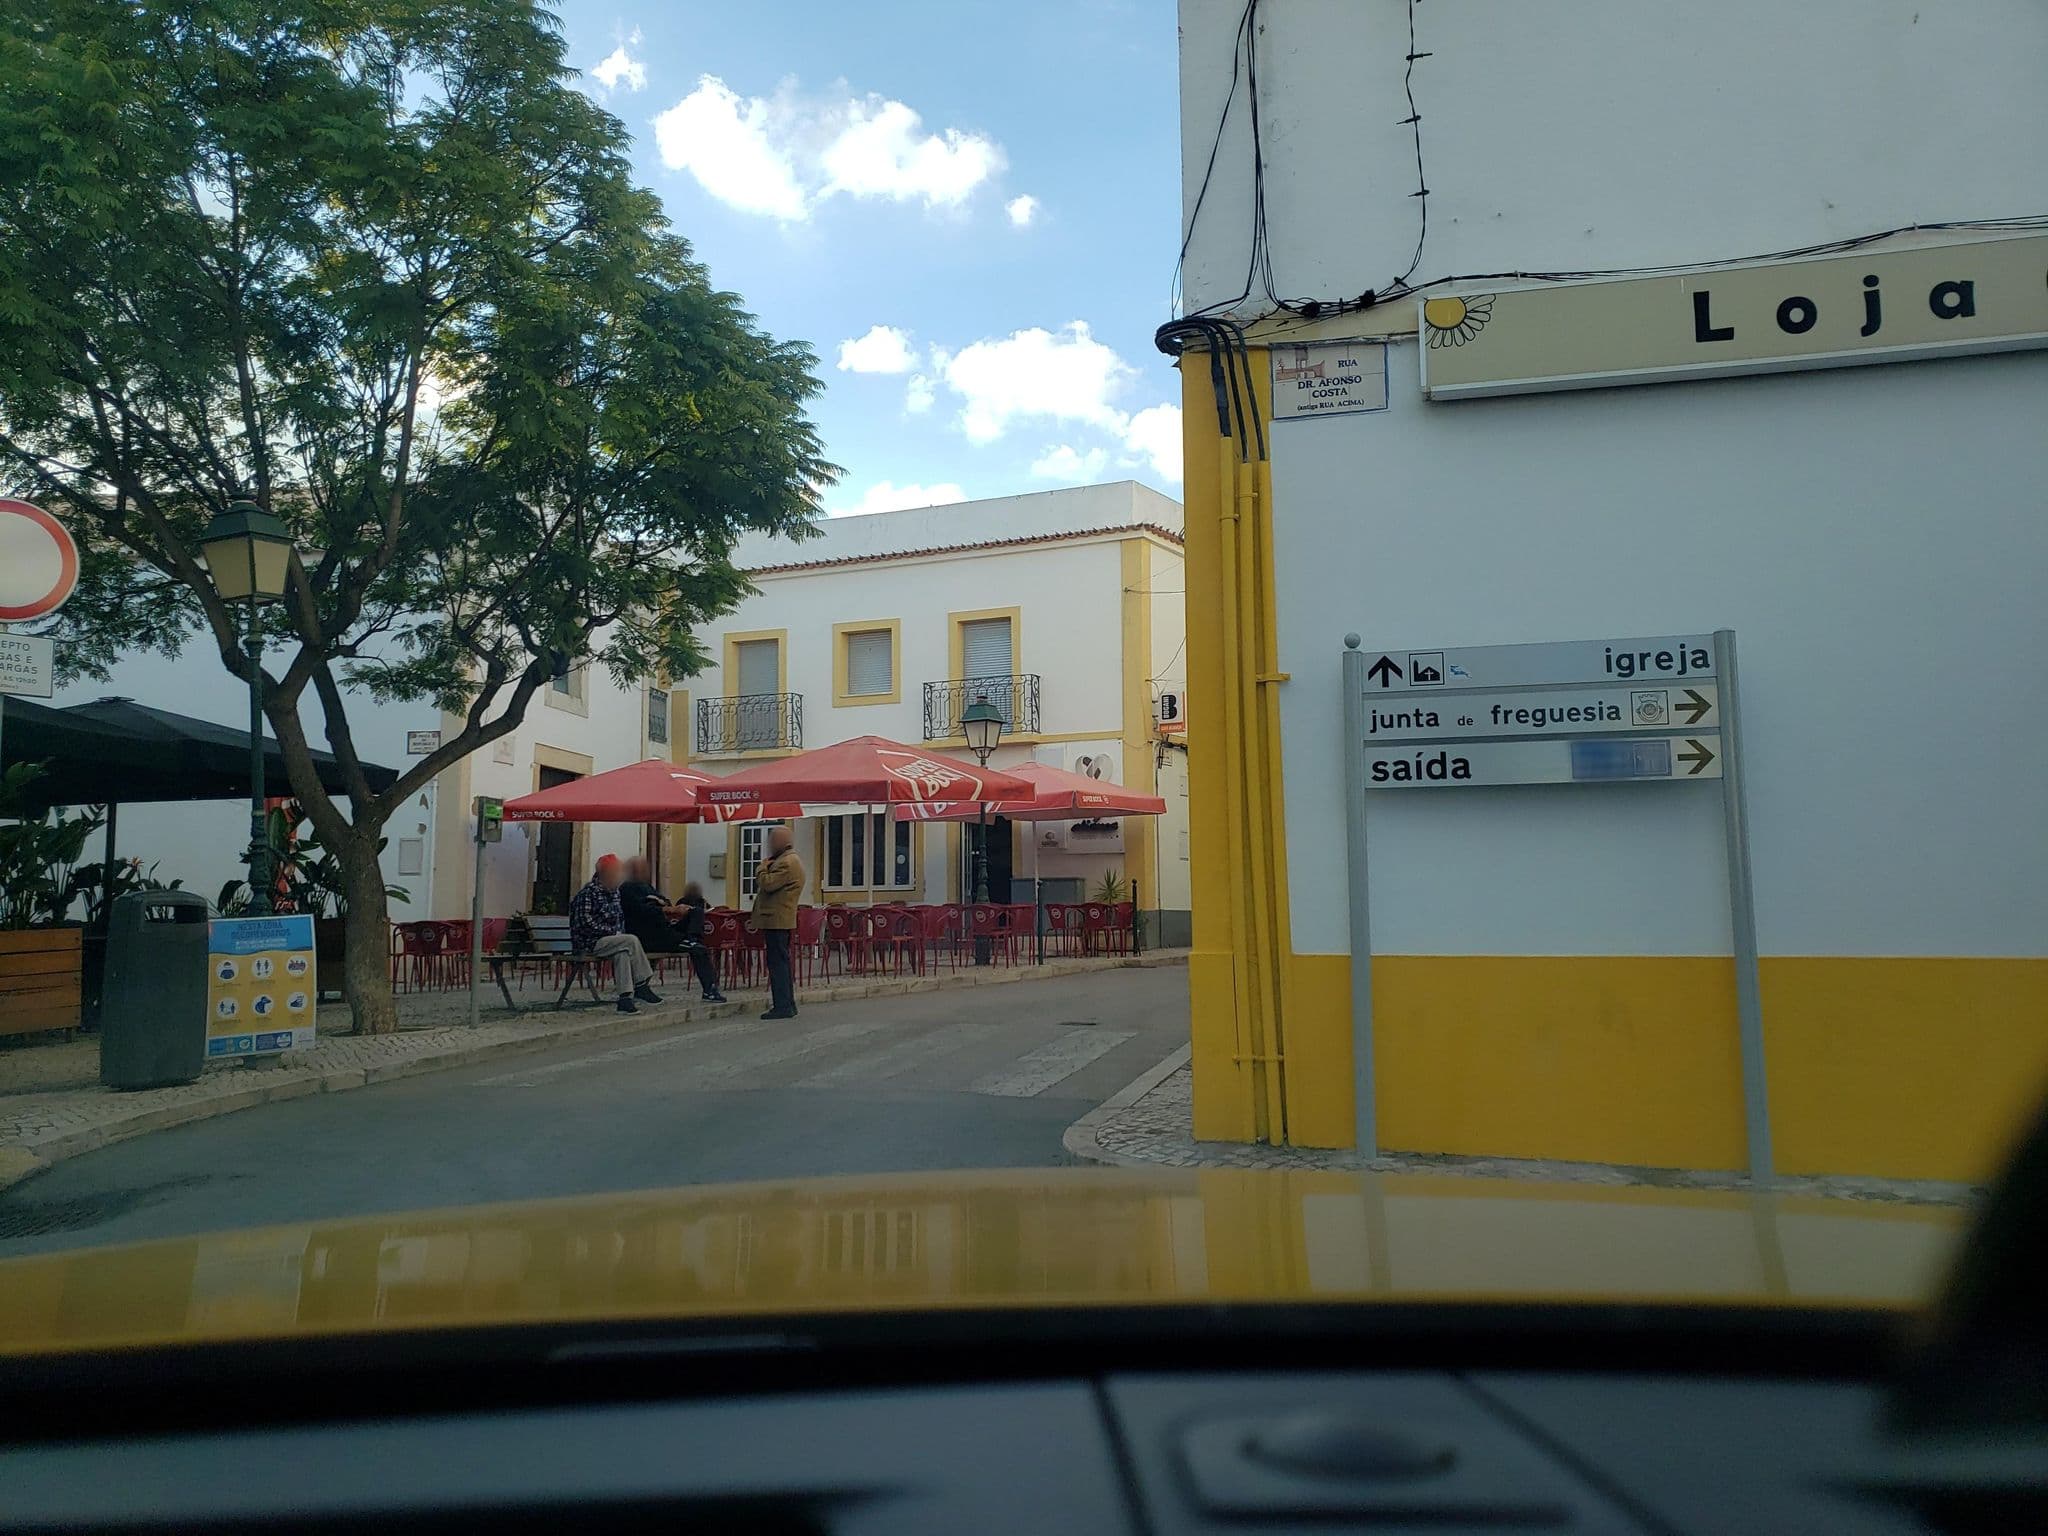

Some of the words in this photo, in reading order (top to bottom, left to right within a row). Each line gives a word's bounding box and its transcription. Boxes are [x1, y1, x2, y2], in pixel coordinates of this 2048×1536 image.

[1692, 274, 1976, 343] Loja
[1338, 359, 1358, 368] RUA
[1298, 381, 1316, 390] DR.
[1319, 376, 1362, 387] AFONSO
[1312, 387, 1348, 398] COSTA
[1338, 399, 1365, 407] ACIMA)
[26, 655, 33, 664] E
[1604, 643, 1711, 678] igreja
[1369, 708, 1440, 733] junta
[1457, 714, 1474, 727] de
[1491, 700, 1623, 728] freguesia
[1371, 751, 1472, 782] saída
